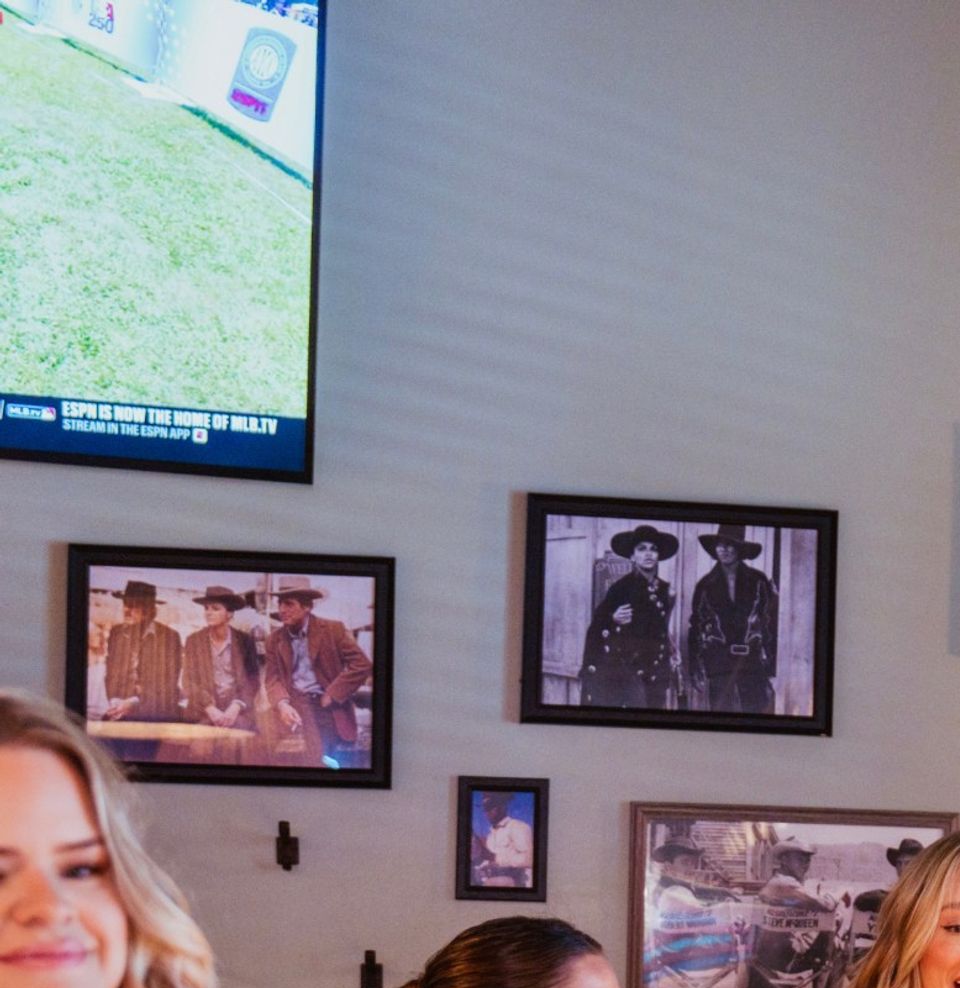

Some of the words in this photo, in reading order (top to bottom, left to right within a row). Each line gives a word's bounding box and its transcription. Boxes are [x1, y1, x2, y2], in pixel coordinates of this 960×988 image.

[61, 400, 97, 419] ESPN
[98, 404, 112, 420] IS
[113, 405, 146, 423] NOW
[147, 408, 172, 426] THE
[173, 410, 211, 429] HOME
[212, 413, 229, 431] OF
[230, 415, 278, 435] MLB.TV
[62, 418, 106, 433] STREAM
[107, 422, 118, 435] IN
[120, 423, 140, 436] THE
[141, 425, 168, 438] ESPN
[169, 427, 191, 440] APP
